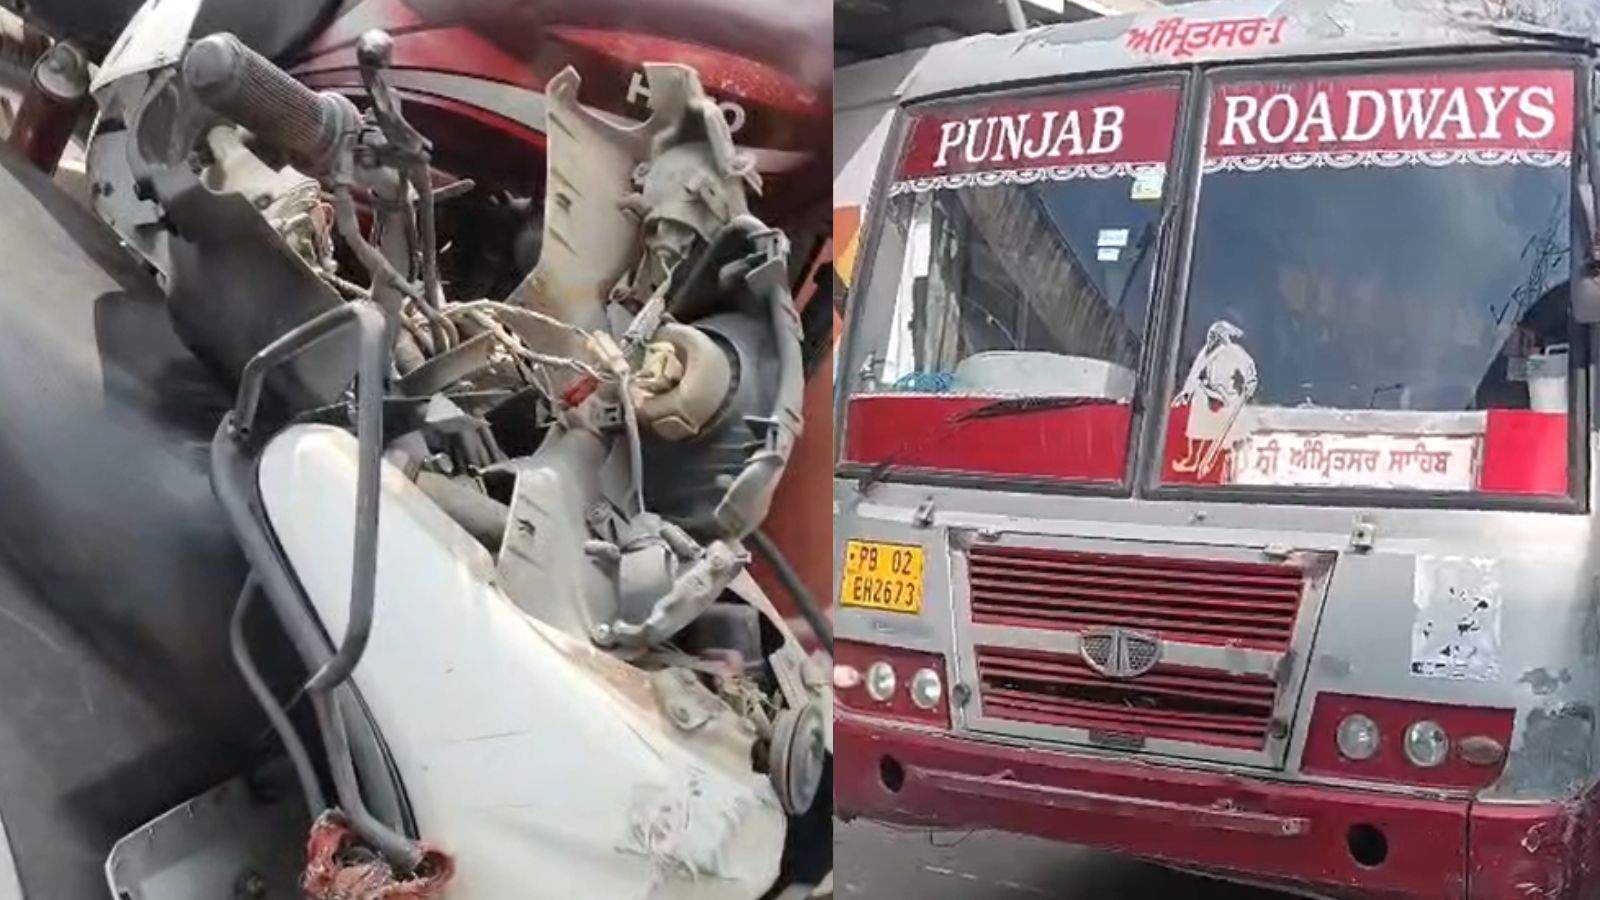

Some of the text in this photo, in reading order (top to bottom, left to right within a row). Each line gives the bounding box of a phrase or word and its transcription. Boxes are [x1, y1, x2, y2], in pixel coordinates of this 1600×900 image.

[627, 71, 746, 133] HO
[932, 86, 1556, 168] PUNJAB ROADWAYS
[859, 546, 912, 575] PB 02
[853, 576, 915, 606] EH2673
